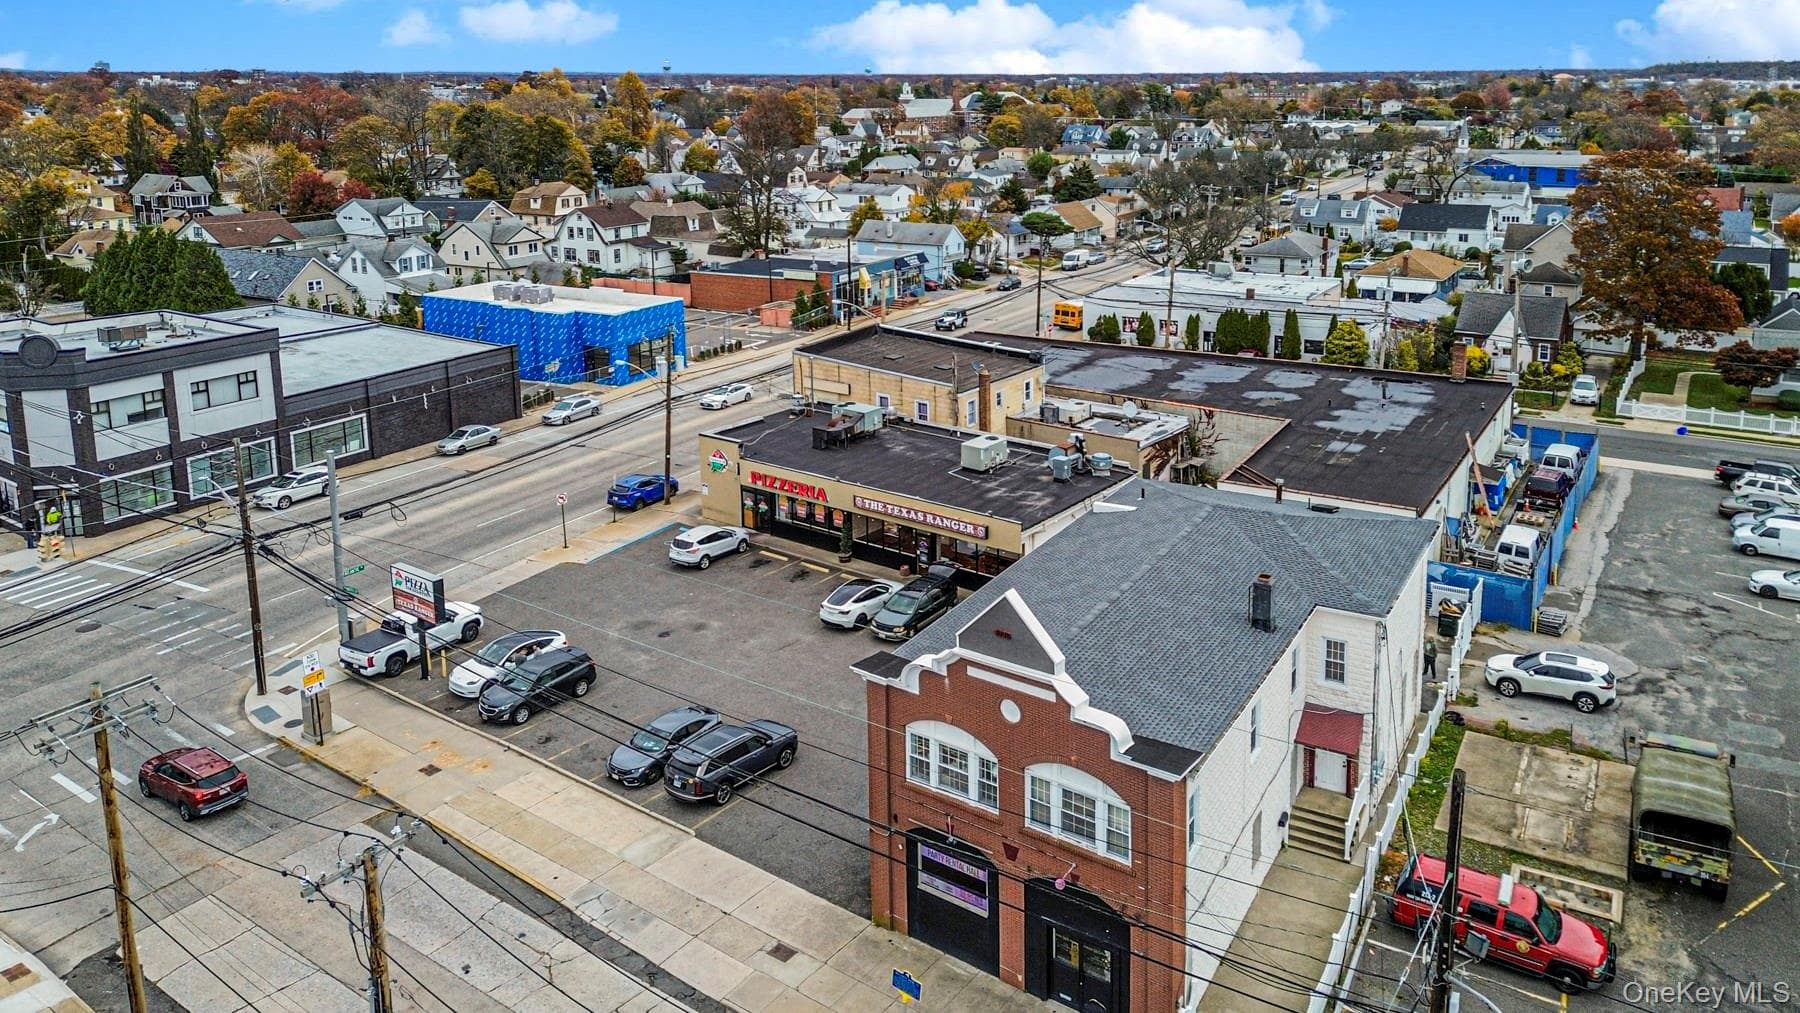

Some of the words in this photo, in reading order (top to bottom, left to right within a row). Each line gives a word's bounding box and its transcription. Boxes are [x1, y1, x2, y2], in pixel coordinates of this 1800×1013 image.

[749, 470, 829, 503] PIZZERIA
[863, 499, 886, 512] THE
[886, 504, 924, 521] TEXAS
[926, 513, 975, 534] RANGER
[404, 575, 432, 598] PIZZA
[927, 848, 945, 862] PARTY
[945, 855, 965, 872] RENTAL
[966, 865, 980, 879] HALL
